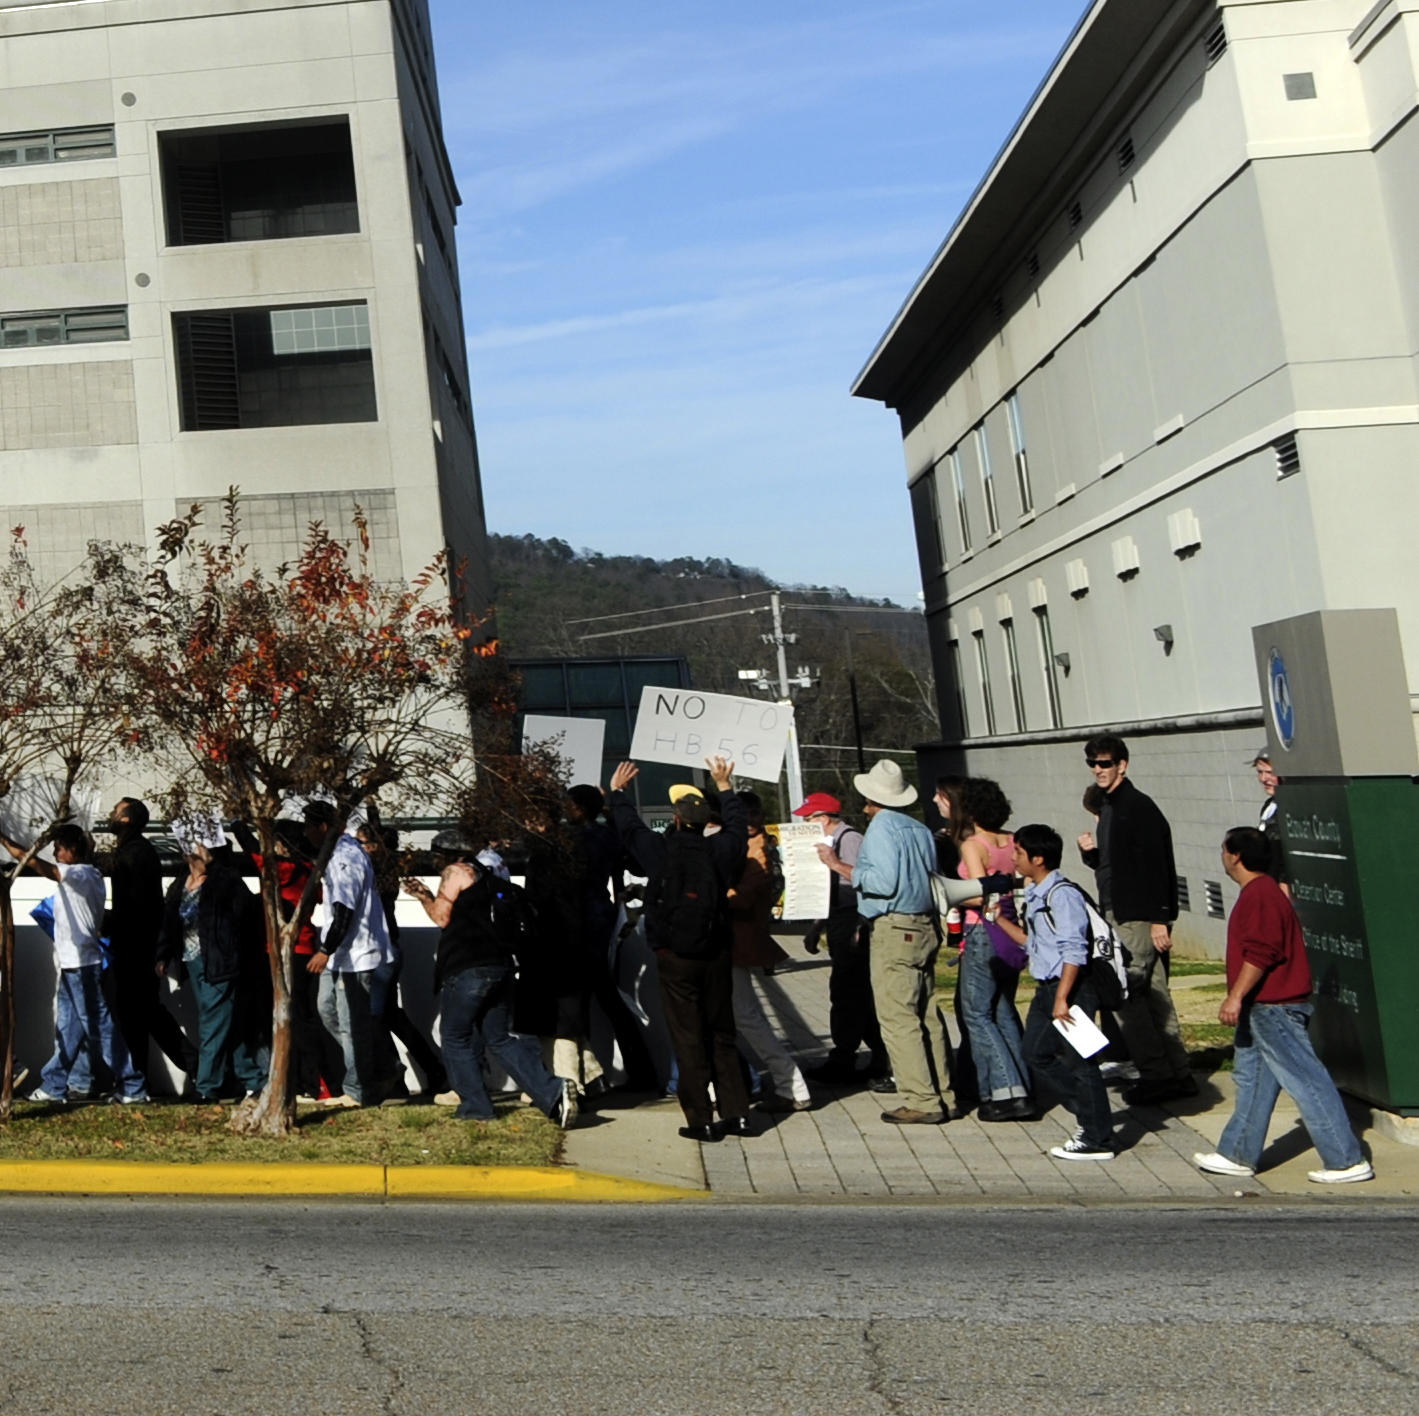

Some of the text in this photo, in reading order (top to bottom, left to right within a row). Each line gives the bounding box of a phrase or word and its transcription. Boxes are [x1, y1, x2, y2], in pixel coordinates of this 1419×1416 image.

[655, 694, 779, 731] NO TO
[653, 731, 760, 765] HB 56
[1312, 814, 1341, 849] County
[1323, 882, 1345, 906] Center
[1302, 926, 1364, 959] Office of the Sheriff
